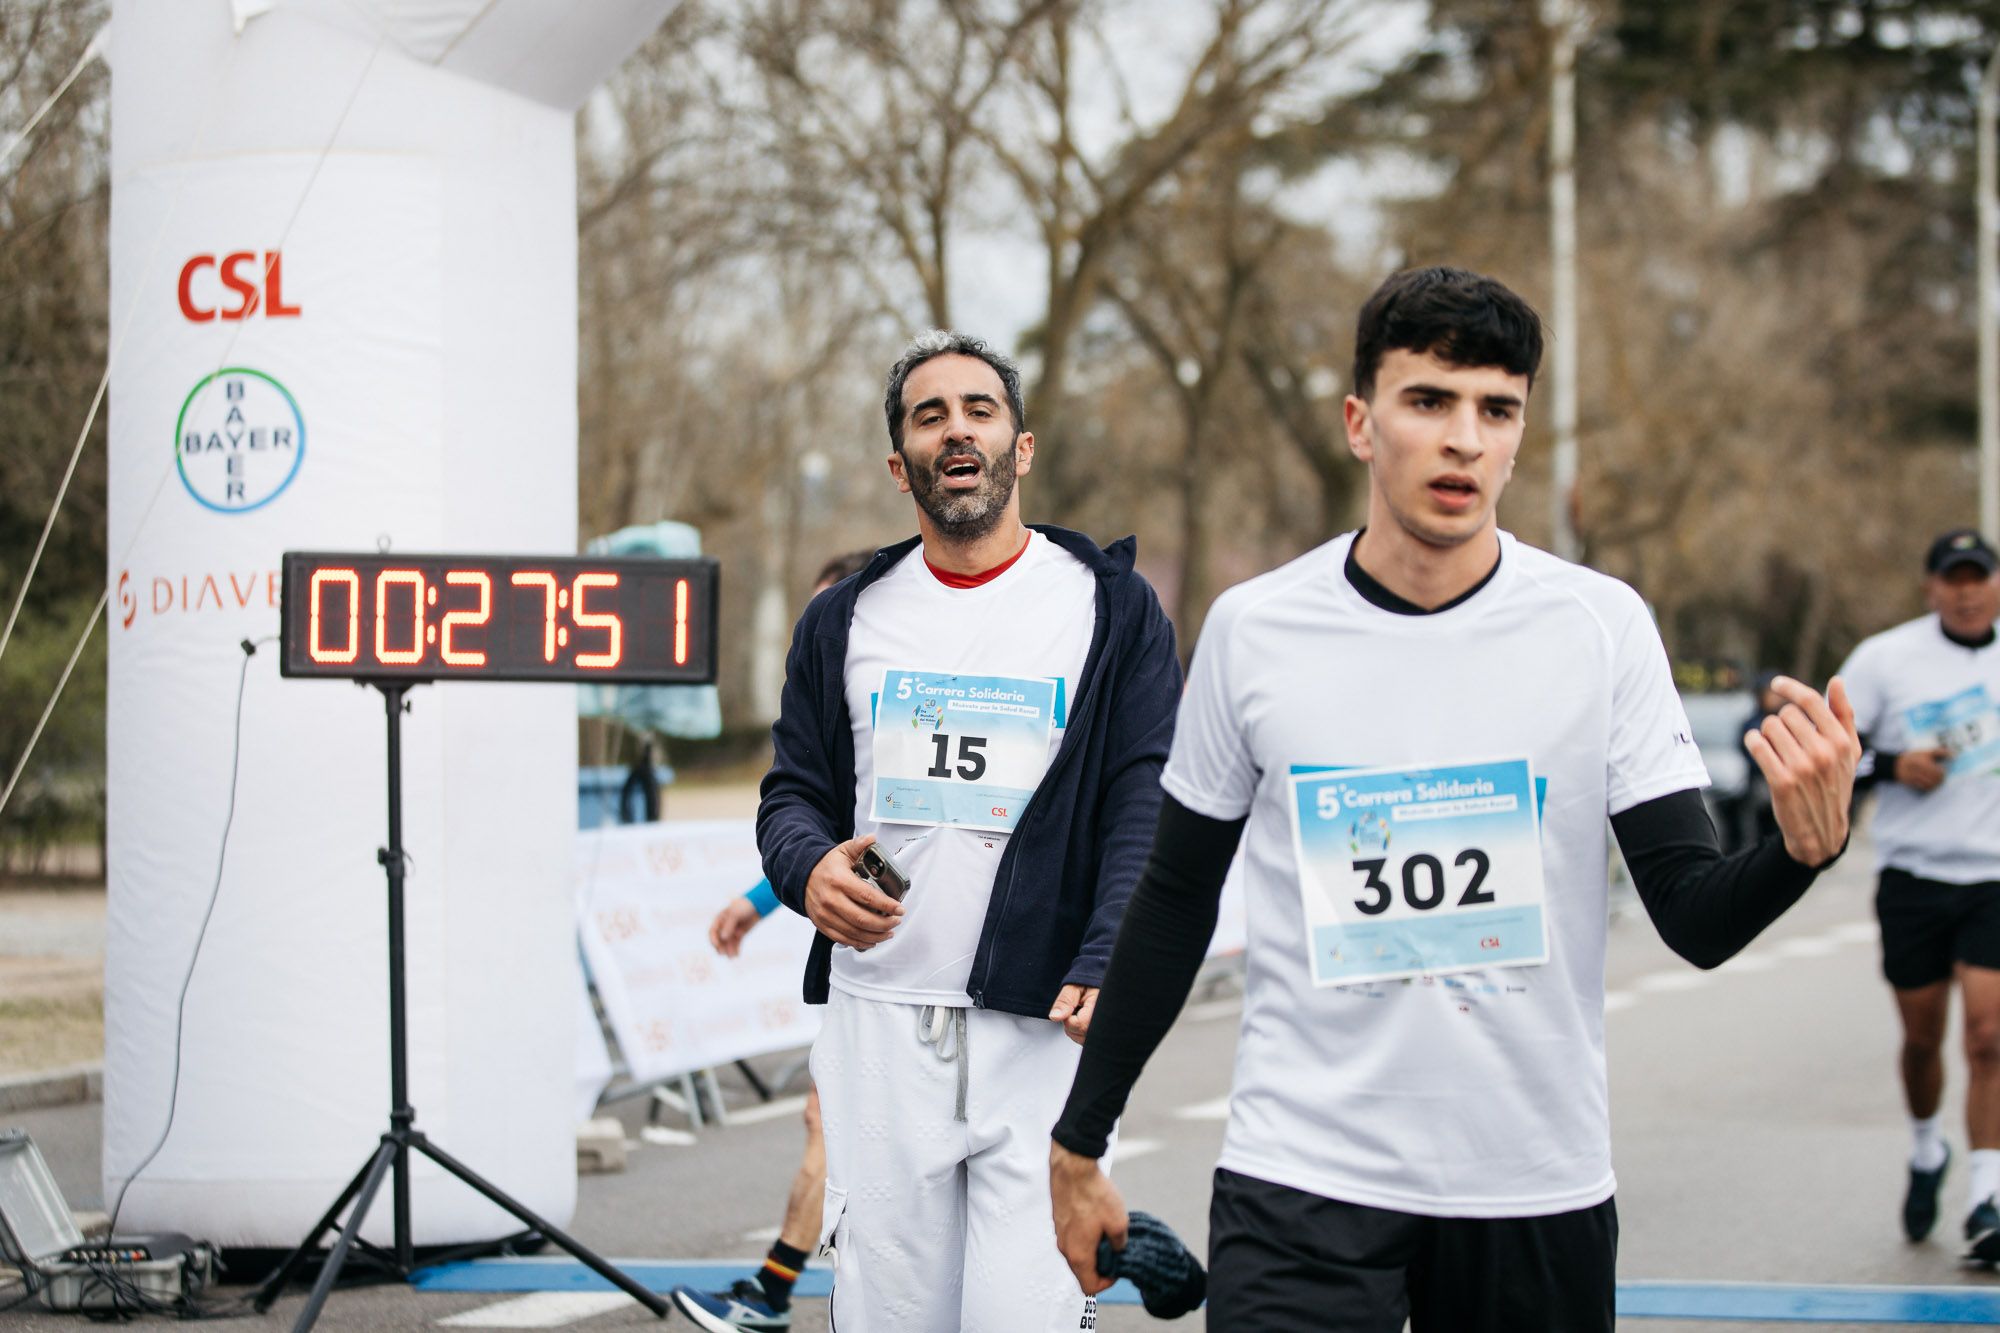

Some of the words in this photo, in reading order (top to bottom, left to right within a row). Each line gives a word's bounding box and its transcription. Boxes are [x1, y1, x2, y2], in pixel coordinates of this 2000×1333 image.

[178, 250, 302, 323] CSL
[185, 428, 292, 453] BAYER
[226, 381, 244, 501] BAYER
[916, 683, 965, 697] Carrera
[968, 687, 1025, 702] Solidaria
[928, 733, 987, 781] 15
[991, 806, 1008, 818] CSL
[1343, 788, 1413, 808] Carrera
[1416, 779, 1495, 801] Solidaria
[1352, 848, 1495, 915] 302
